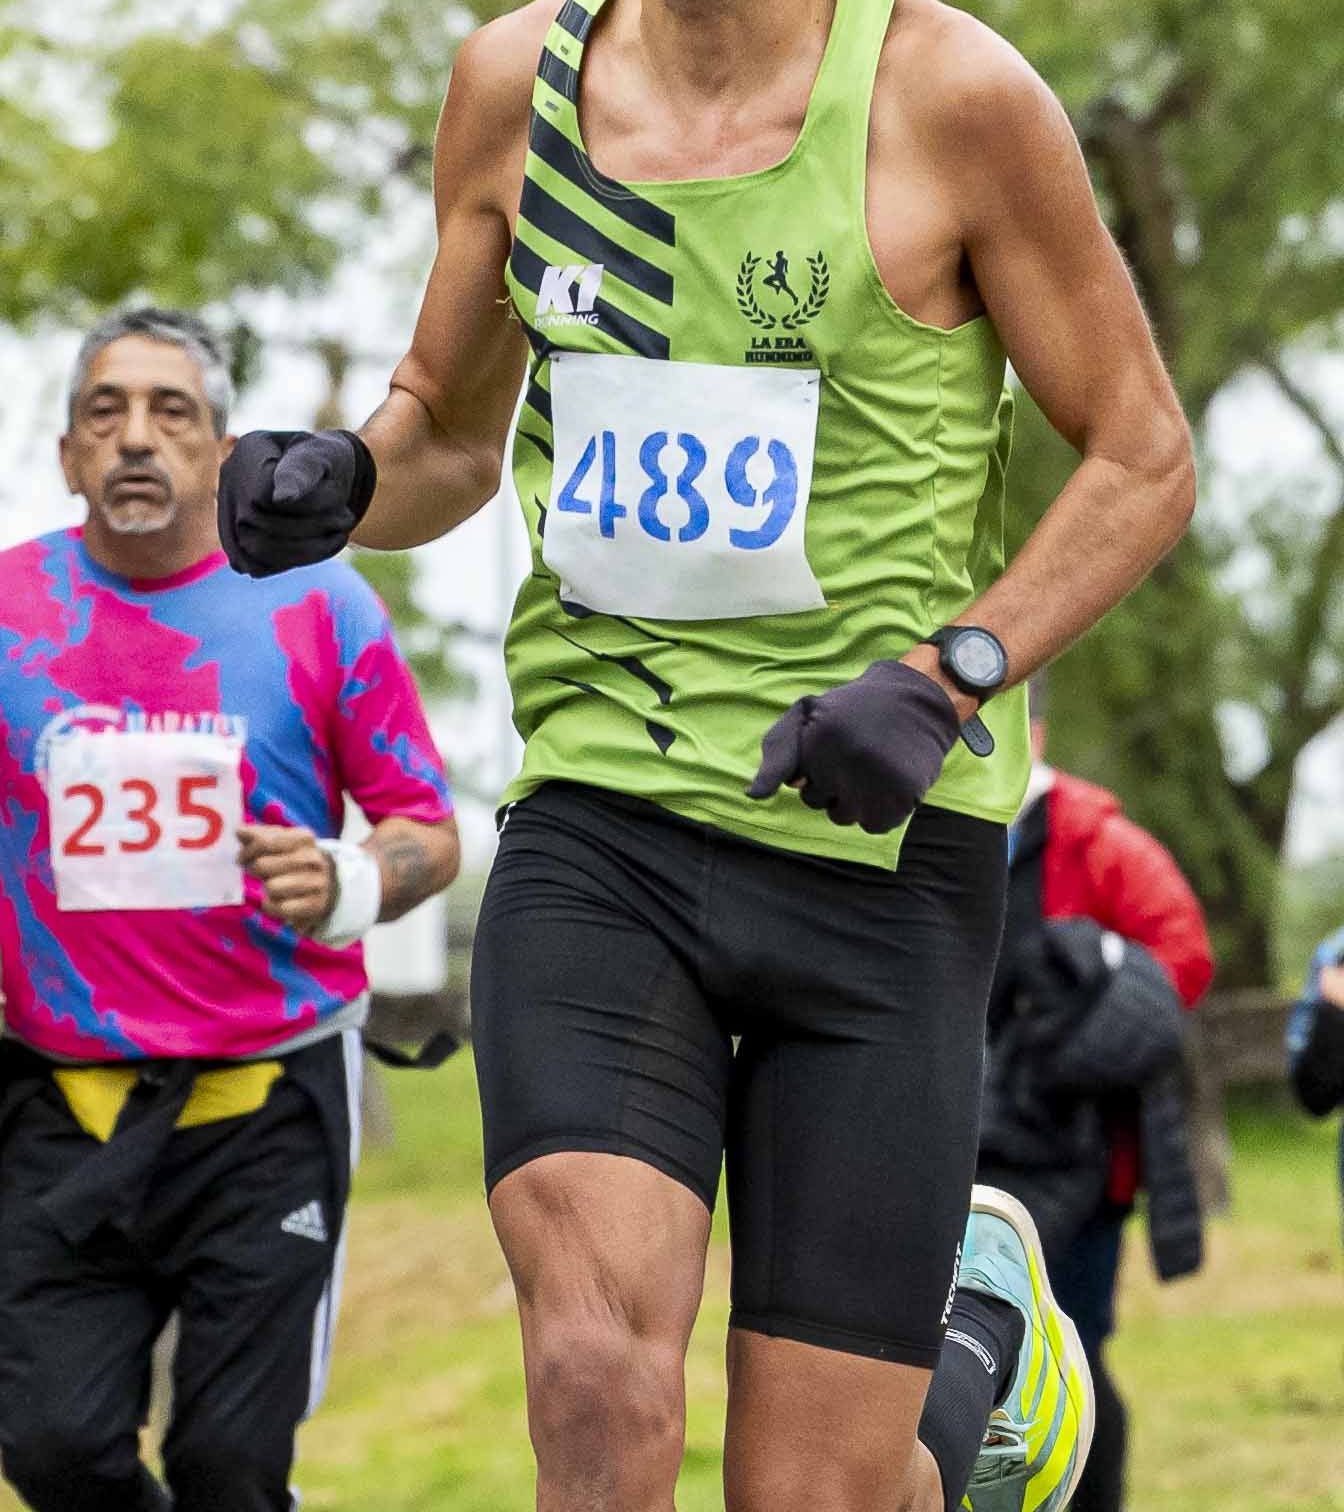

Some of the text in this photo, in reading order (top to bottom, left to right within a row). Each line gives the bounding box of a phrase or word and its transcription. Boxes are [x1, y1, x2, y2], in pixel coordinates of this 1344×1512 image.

[536, 263, 604, 315] K1
[751, 336, 807, 349] LA ERA
[556, 430, 799, 551] 489
[62, 775, 224, 857] 235
